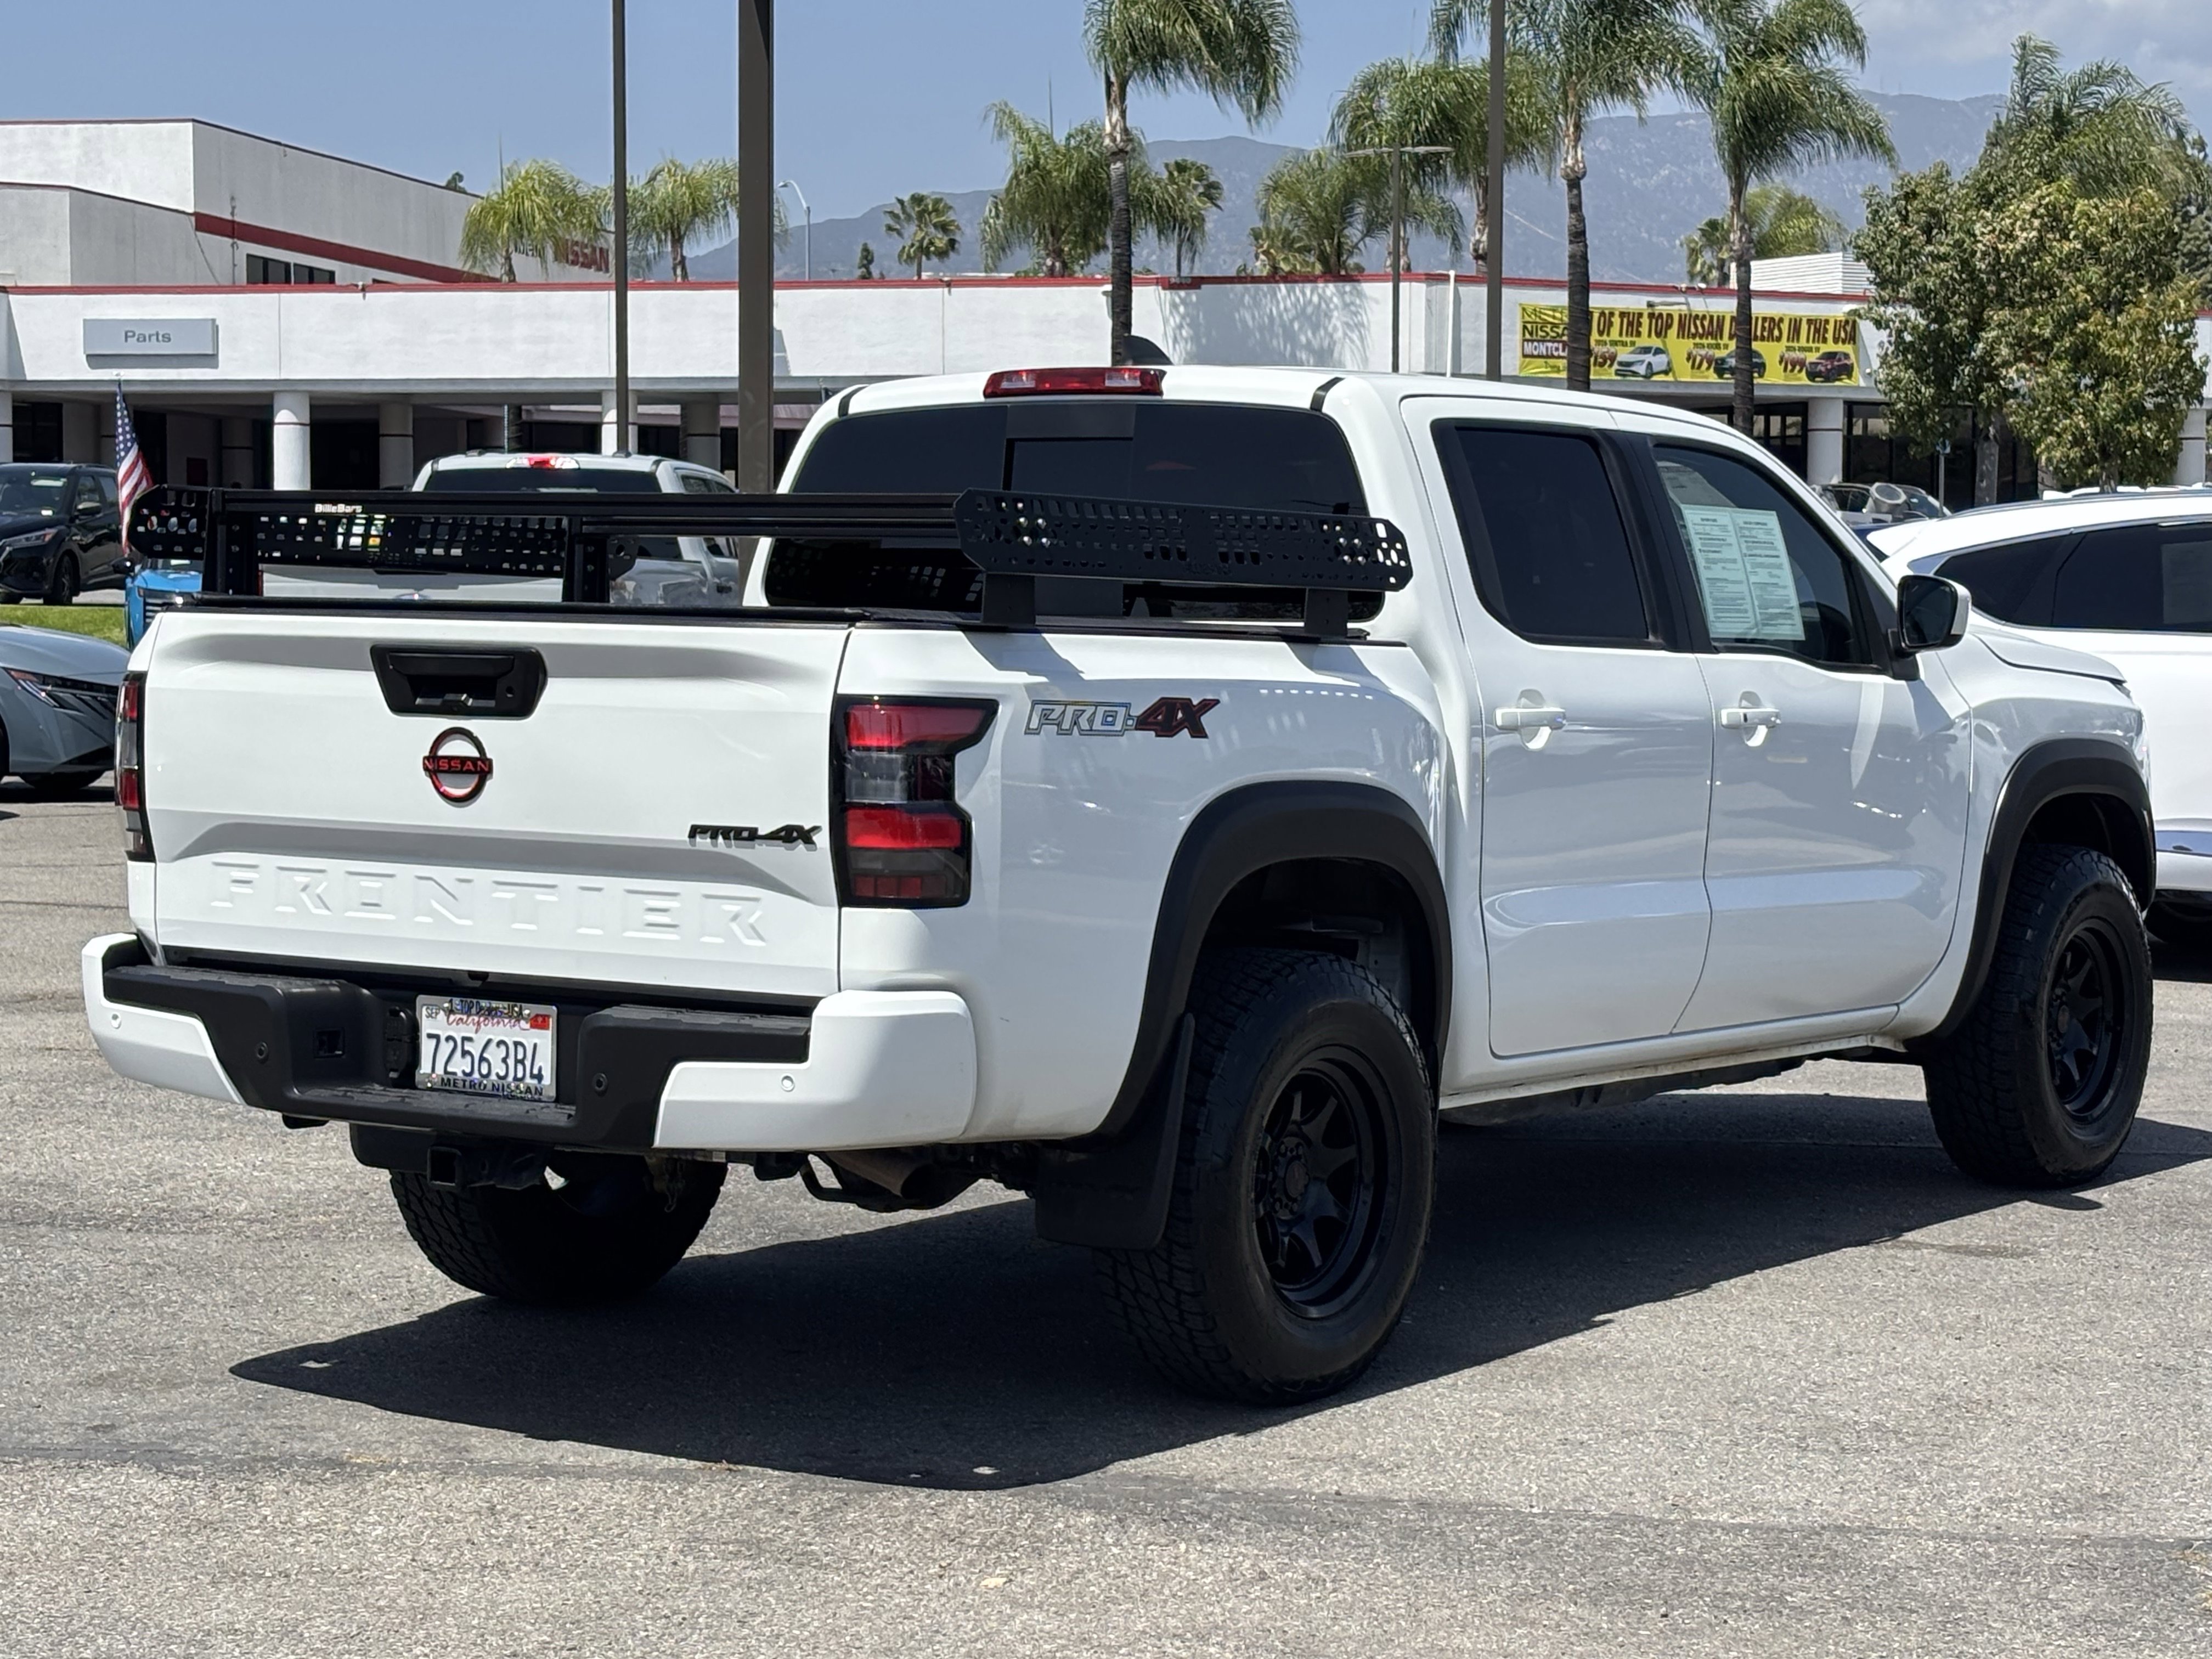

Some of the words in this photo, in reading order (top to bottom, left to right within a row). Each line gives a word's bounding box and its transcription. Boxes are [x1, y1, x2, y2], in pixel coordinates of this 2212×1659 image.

[124, 330, 172, 343] Parts
[1522, 324, 1568, 339] NISSA
[1597, 310, 1616, 338] OF
[1618, 311, 1644, 338] THE
[1646, 312, 1674, 340] TOP
[1675, 313, 1725, 342] NISSAN
[1728, 315, 1785, 343] DLERS
[1786, 316, 1803, 343] IN
[1805, 318, 1830, 345] THE
[1831, 319, 1858, 346] USA
[1523, 341, 1568, 357] MONTCL
[1686, 348, 1716, 371] $179
[1779, 351, 1807, 374] $199
[1024, 696, 1221, 739] PRO-4X
[424, 758, 489, 772] NISSAN
[687, 824, 822, 844] PRO-4X
[210, 861, 767, 946] FRONTIER
[425, 1007, 440, 1020] SEP
[446, 1011, 531, 1034] California
[426, 1032, 544, 1085] 72563B4
[441, 1077, 488, 1091] METRO
[492, 1081, 544, 1096] NISSAN
